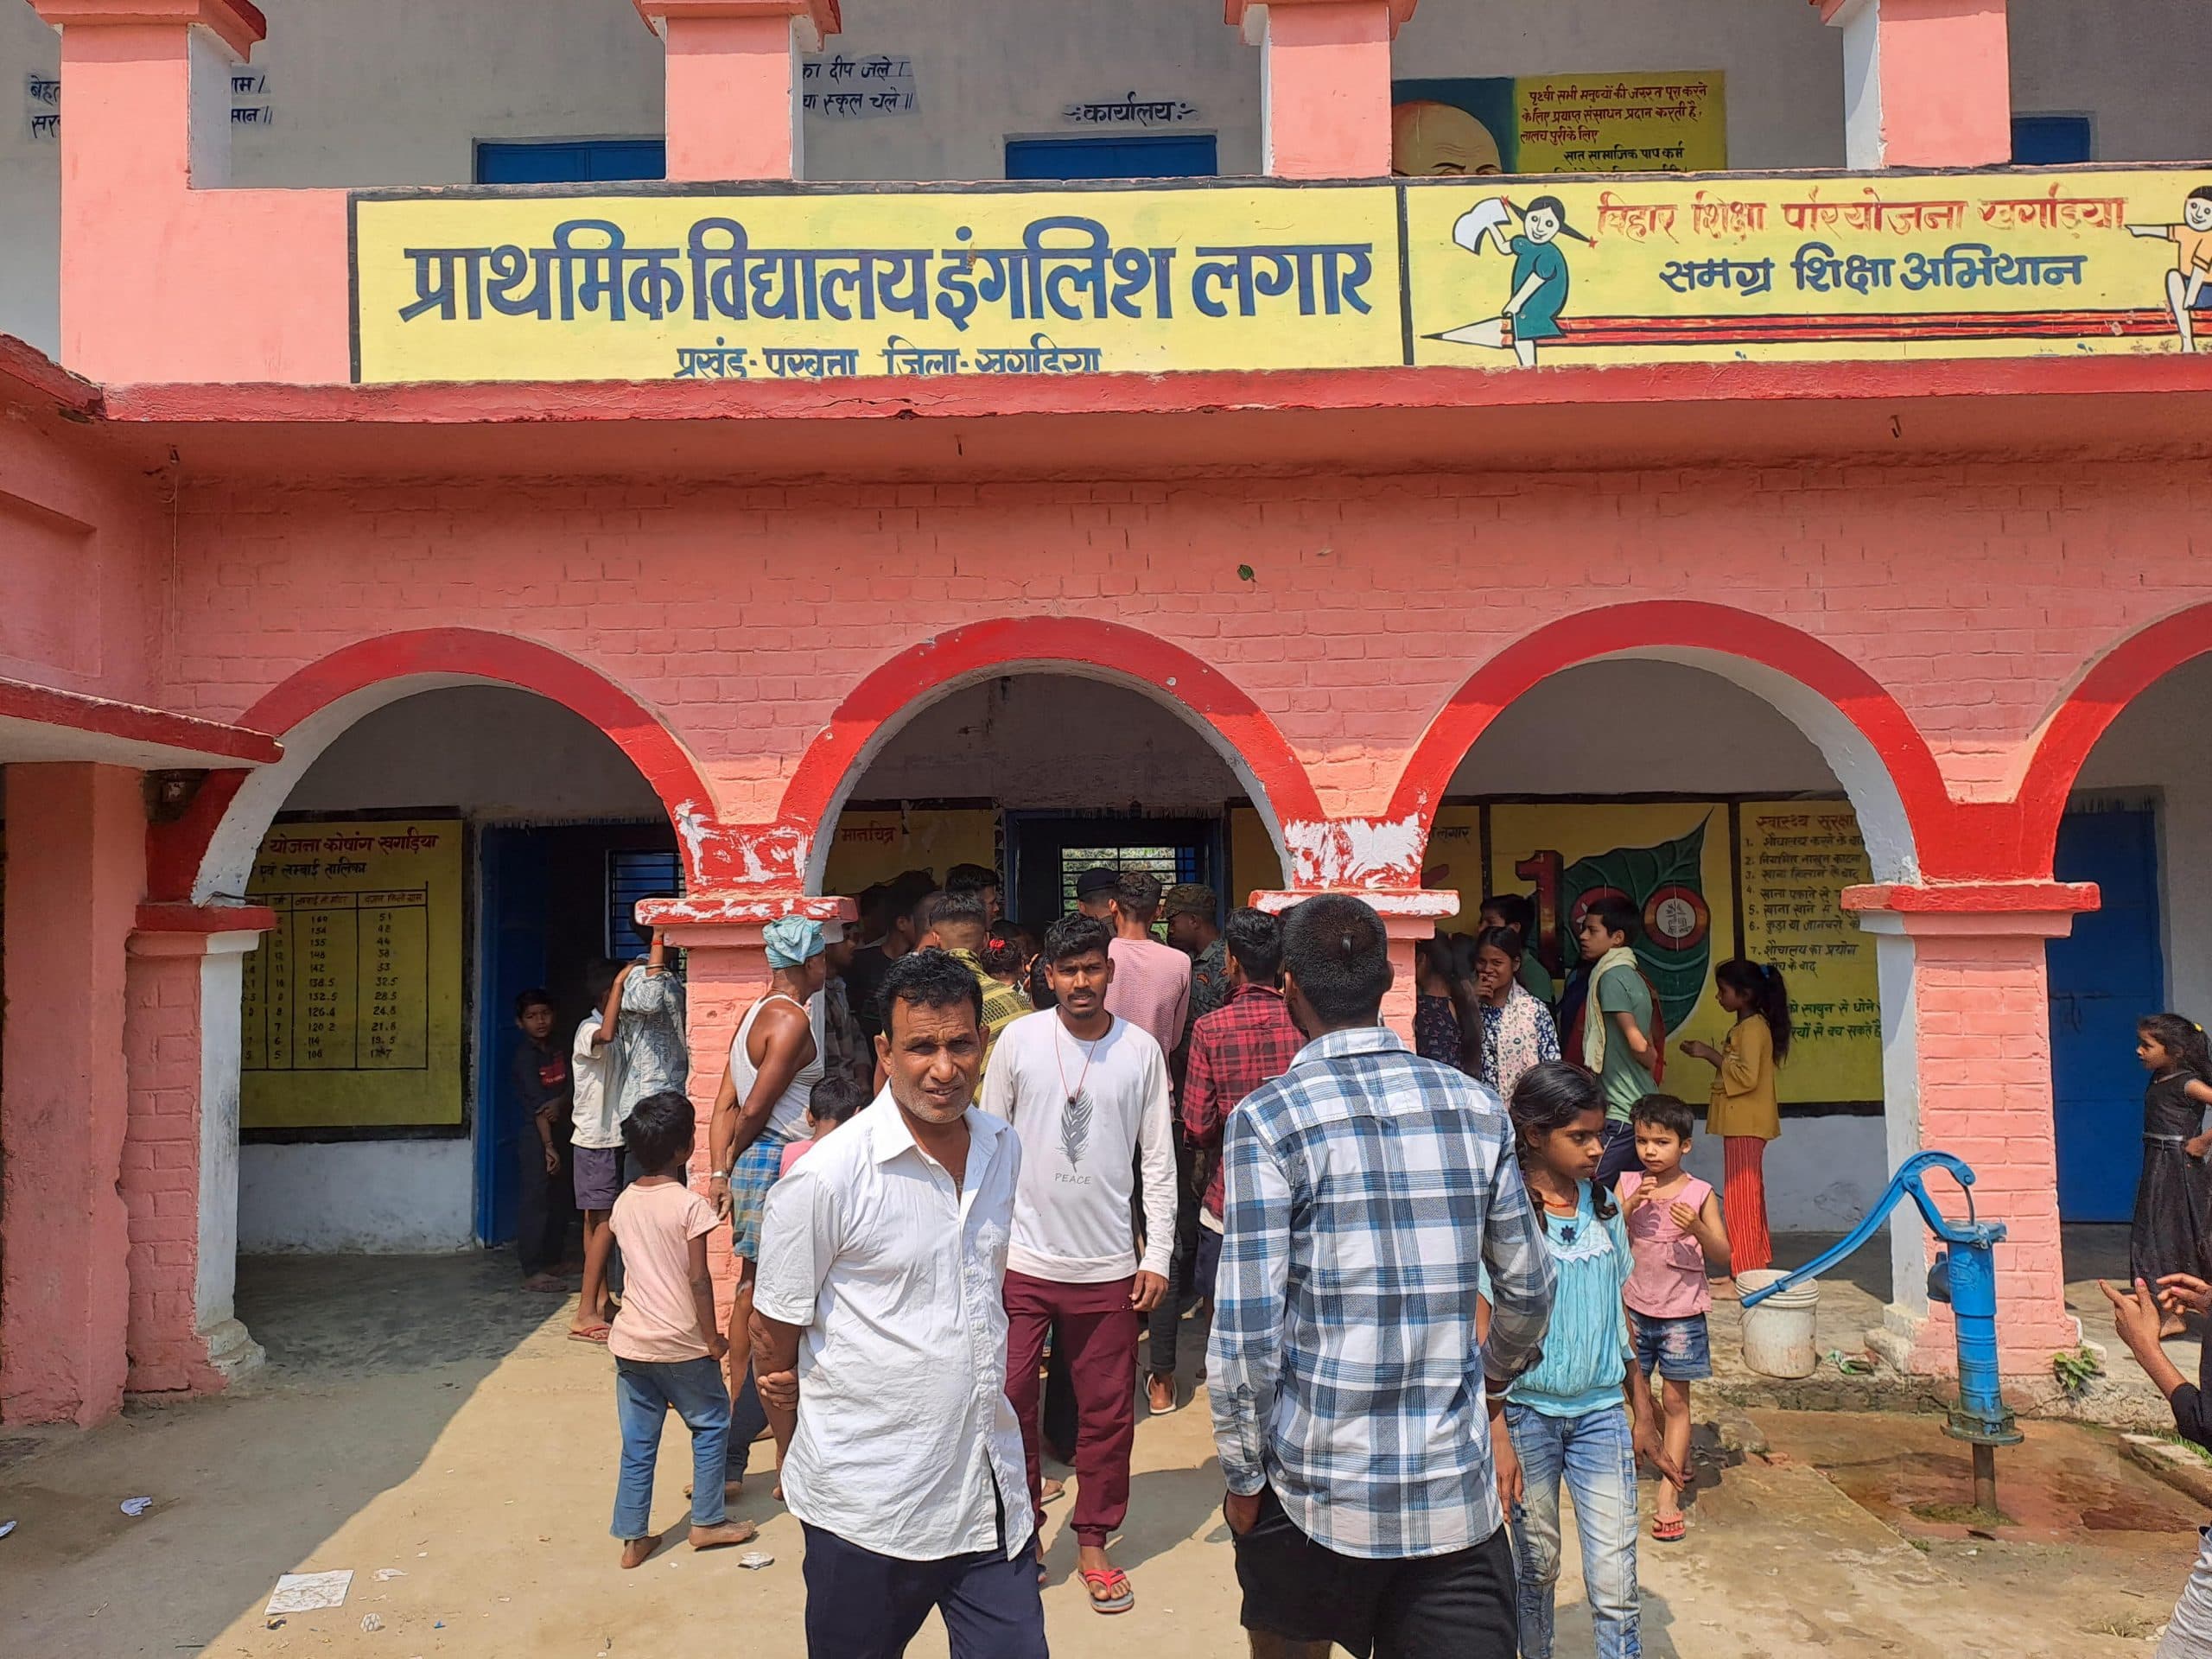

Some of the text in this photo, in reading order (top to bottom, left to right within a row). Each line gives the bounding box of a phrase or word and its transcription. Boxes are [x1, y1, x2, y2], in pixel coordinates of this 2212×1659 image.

[830, 54, 856, 85] दीप
[861, 55, 893, 81] जले
[823, 92, 863, 118] स्कूल
[869, 86, 900, 113] चले
[1556, 84, 1578, 105] सभी
[1613, 82, 1628, 101] की
[1682, 81, 1708, 101] करने
[1583, 105, 1622, 124] संसाधन
[1624, 106, 1653, 123] प्रदान
[1655, 100, 1688, 124] करती
[1521, 130, 1549, 144] लालच
[1578, 125, 1599, 144] लिए
[1563, 150, 1585, 165] सात
[1588, 143, 1638, 165] सामाजिक
[1640, 148, 1660, 160] पाप
[1597, 190, 1680, 245] बिहार
[1690, 189, 1767, 241] शिक्षा
[398, 216, 1373, 333] प्राथमिक विद्यालय इंगलिश लगार
[1658, 241, 2088, 297] समग्र शिक्षा अभियान
[269, 832, 322, 854] योजना
[378, 825, 440, 855] खगड़िया
[840, 819, 897, 844] मानचित्र
[1802, 1001, 1836, 1019] साबुन
[1839, 999, 1849, 1016] से
[1853, 997, 1876, 1013] धोने
[1054, 1172, 1093, 1185] PEACE
